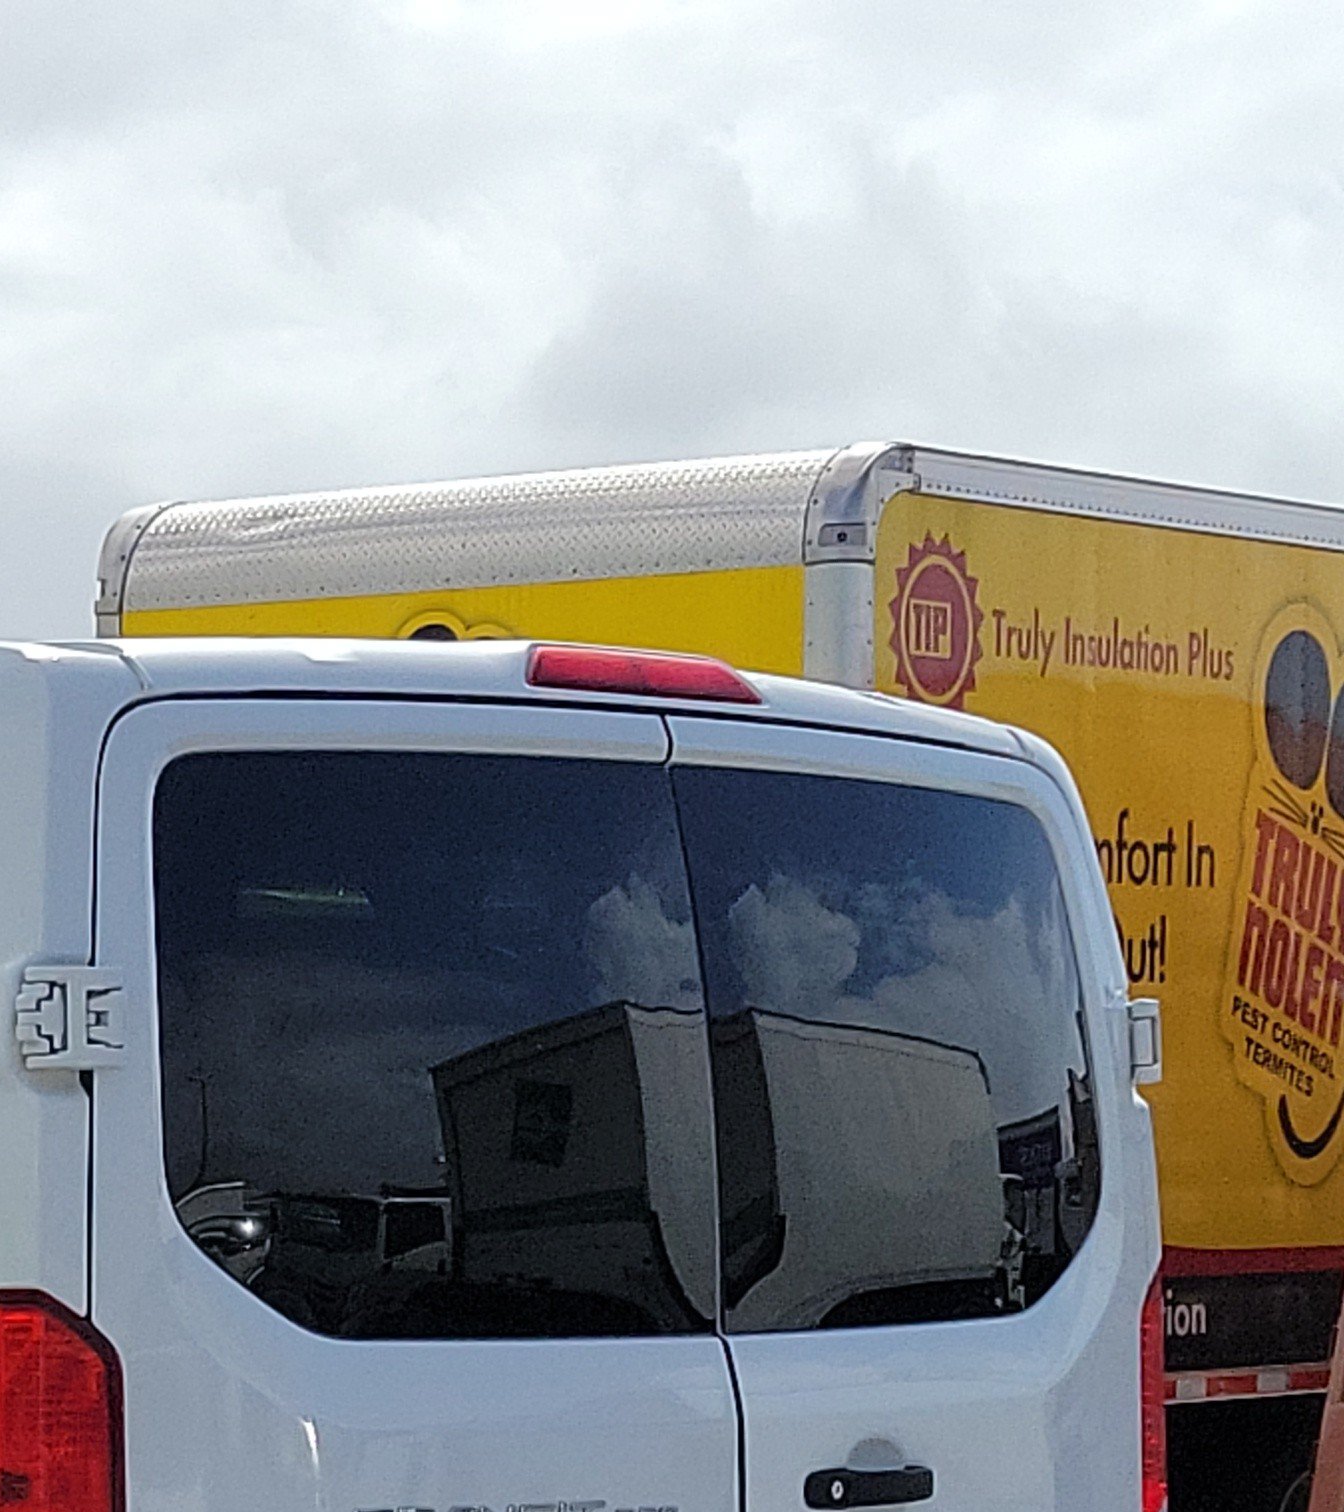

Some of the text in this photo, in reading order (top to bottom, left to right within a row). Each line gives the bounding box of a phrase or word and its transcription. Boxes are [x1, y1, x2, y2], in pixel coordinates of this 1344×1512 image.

[912, 604, 949, 653] TIP
[992, 606, 1234, 681] Truly Insulation Plus
[1186, 819, 1215, 887] In
[1231, 995, 1335, 1080] PEST CONTROL
[1245, 1036, 1314, 1097] TERMITES
[1162, 1288, 1207, 1337] ion
